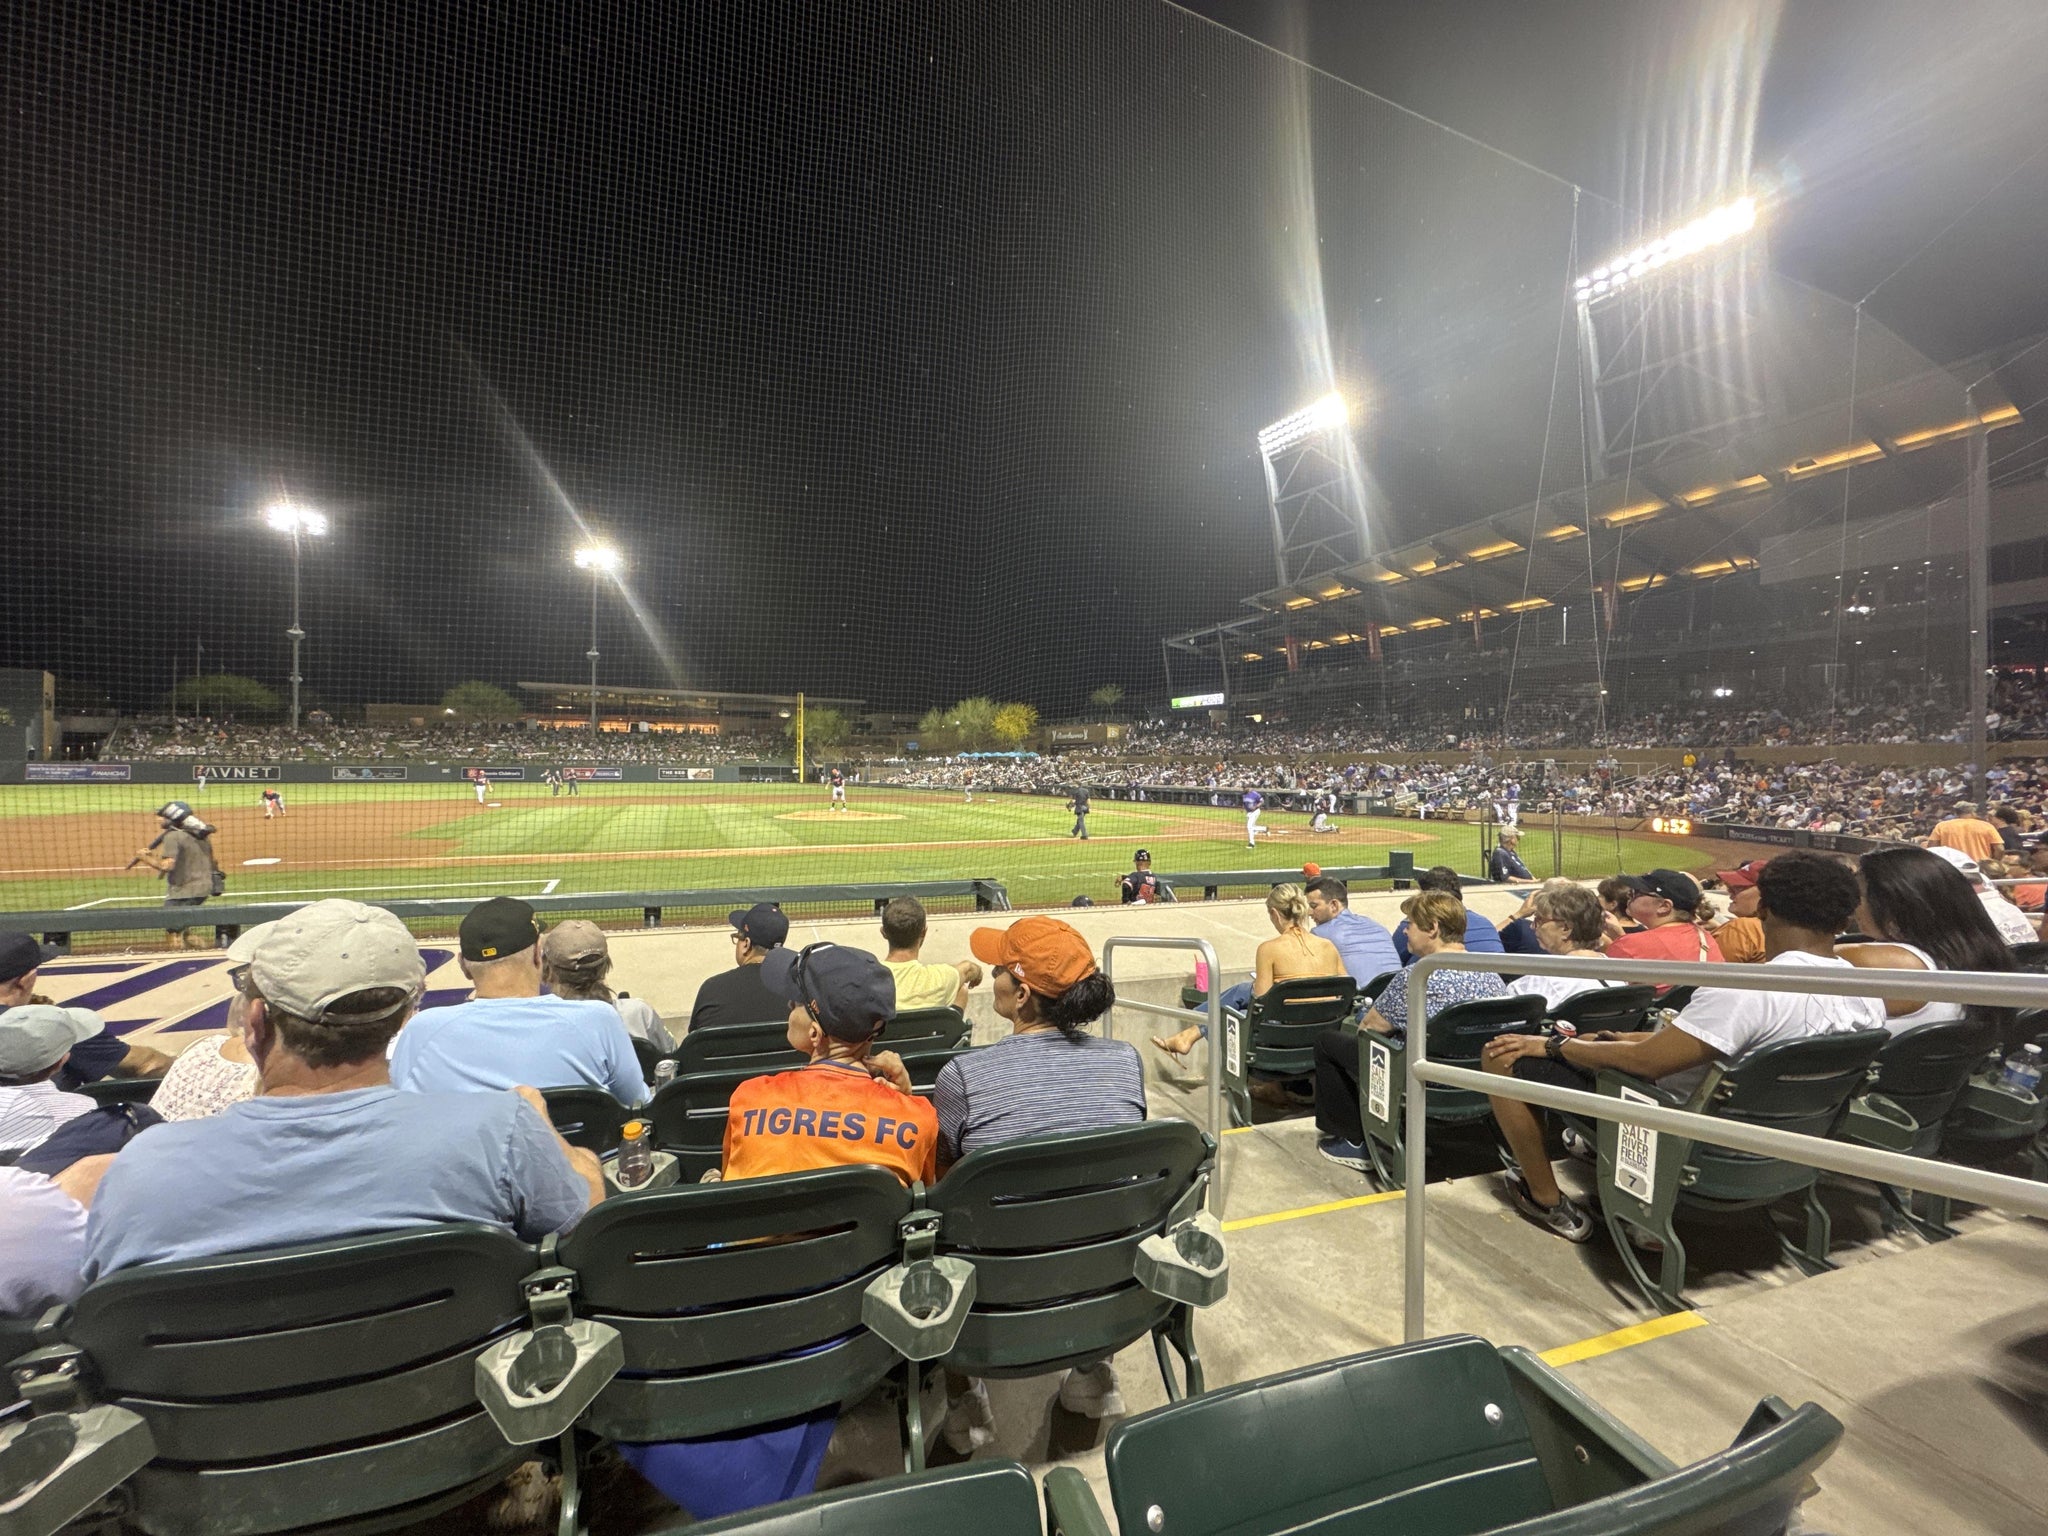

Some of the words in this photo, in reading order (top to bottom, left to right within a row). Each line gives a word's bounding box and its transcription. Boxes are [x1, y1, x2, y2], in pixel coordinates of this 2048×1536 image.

[205, 767, 272, 778] AVNET
[743, 1107, 867, 1141] TIGRES
[874, 1116, 919, 1150] FC
[1622, 1122, 1649, 1141] SALT
[1621, 1134, 1649, 1157] RIVER
[1620, 1145, 1648, 1168] FIELDS
[1628, 1174, 1637, 1188] 7
